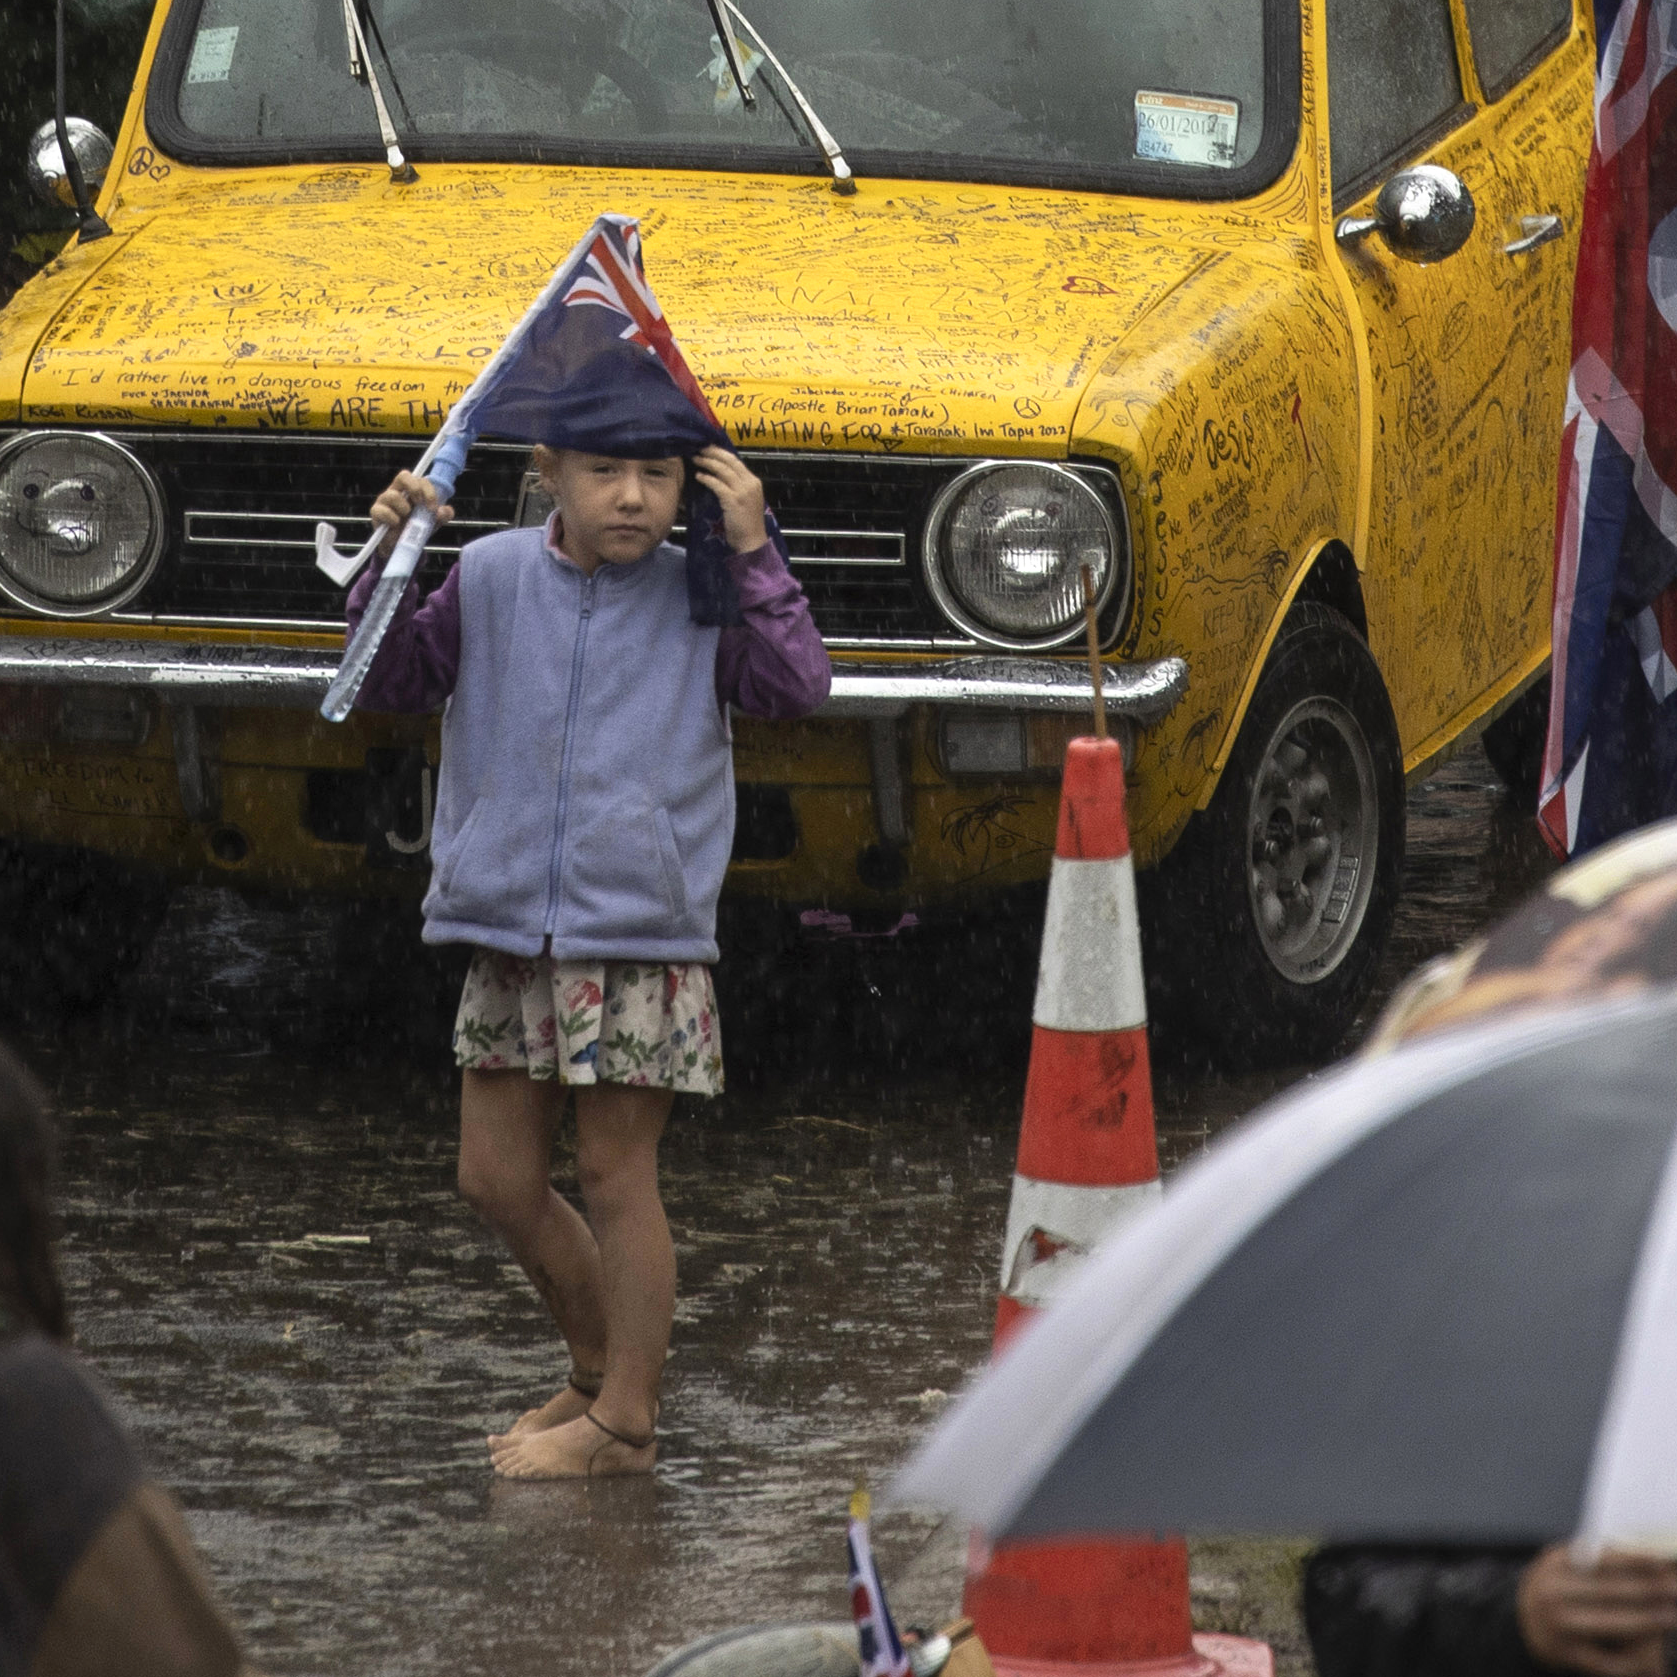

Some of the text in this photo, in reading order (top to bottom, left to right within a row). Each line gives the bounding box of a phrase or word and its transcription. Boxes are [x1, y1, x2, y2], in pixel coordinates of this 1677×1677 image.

[1302, 49, 1316, 126] FREEDOM
[117, 370, 171, 385] rather
[180, 370, 208, 386] live
[217, 371, 236, 386] in
[249, 371, 342, 394] dangerous
[355, 375, 426, 392] freedom
[758, 396, 828, 416] (Apostle
[835, 400, 878, 417] Brian
[265, 396, 311, 427] WE
[330, 396, 386, 428] ARE
[734, 415, 835, 446] WAITING
[841, 422, 884, 444] FOR
[906, 420, 967, 438] Taranaki
[999, 422, 1035, 441] Tapu
[1038, 424, 1067, 437] 2022
